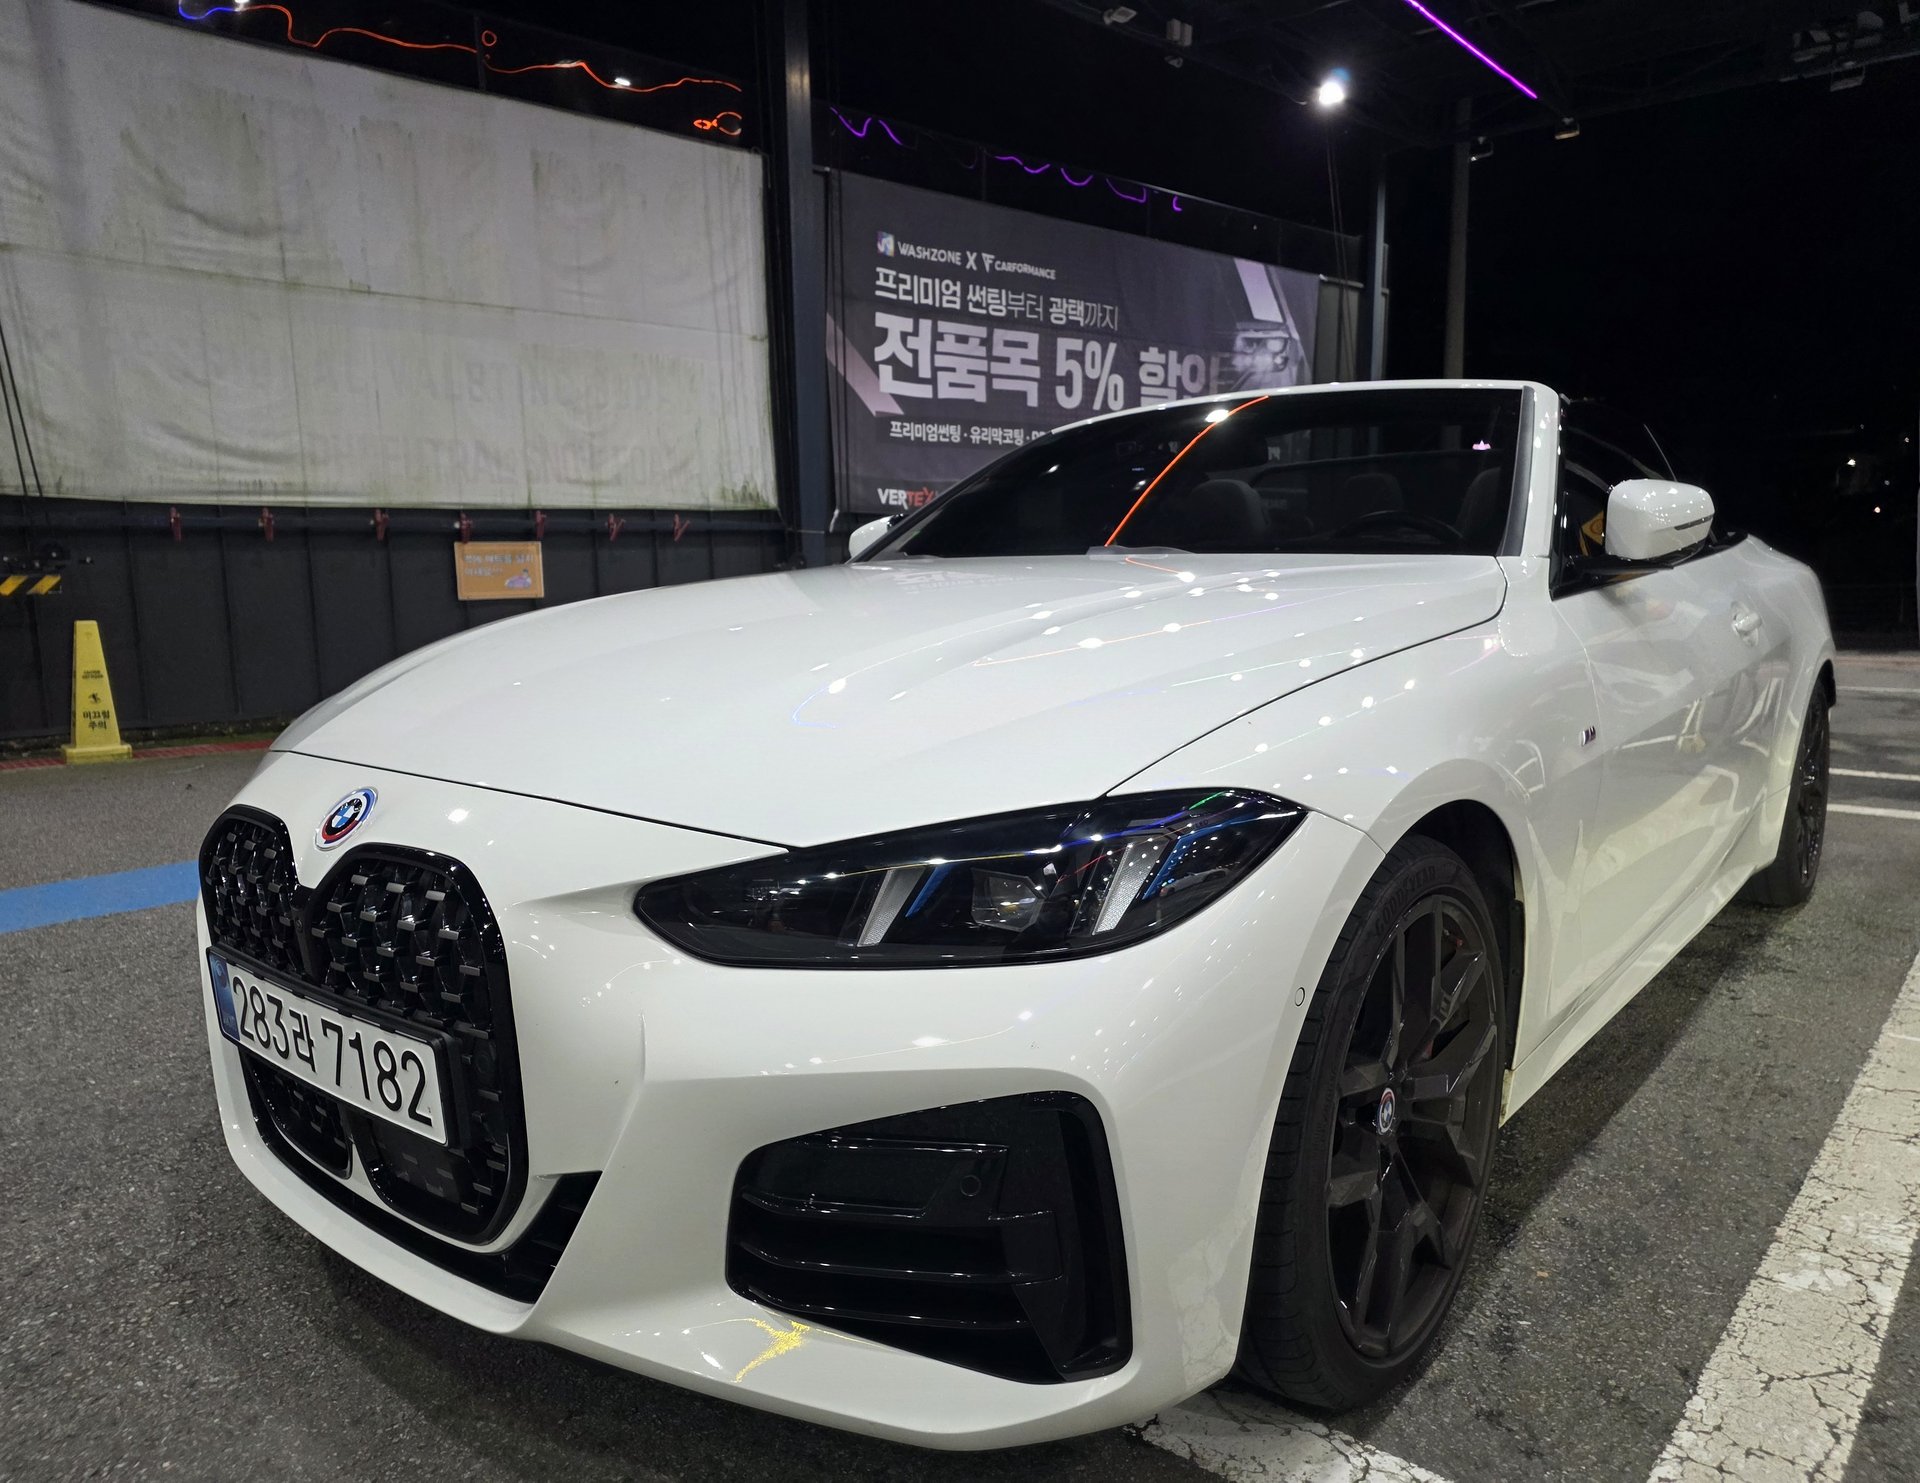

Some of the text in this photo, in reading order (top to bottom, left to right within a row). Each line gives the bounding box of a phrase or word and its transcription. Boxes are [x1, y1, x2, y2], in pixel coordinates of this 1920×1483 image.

[898, 241, 1057, 280] WASHZONE X CARFORMANCE
[875, 267, 1119, 332] 프리미엄 썬팅부터 광택까지
[874, 311, 1041, 408] 전품목
[1056, 337, 1125, 411] 5%
[890, 421, 961, 443] 프리미엄썬팅
[969, 427, 1024, 446] 유리막코팅
[233, 976, 433, 1127] 283라 7182
